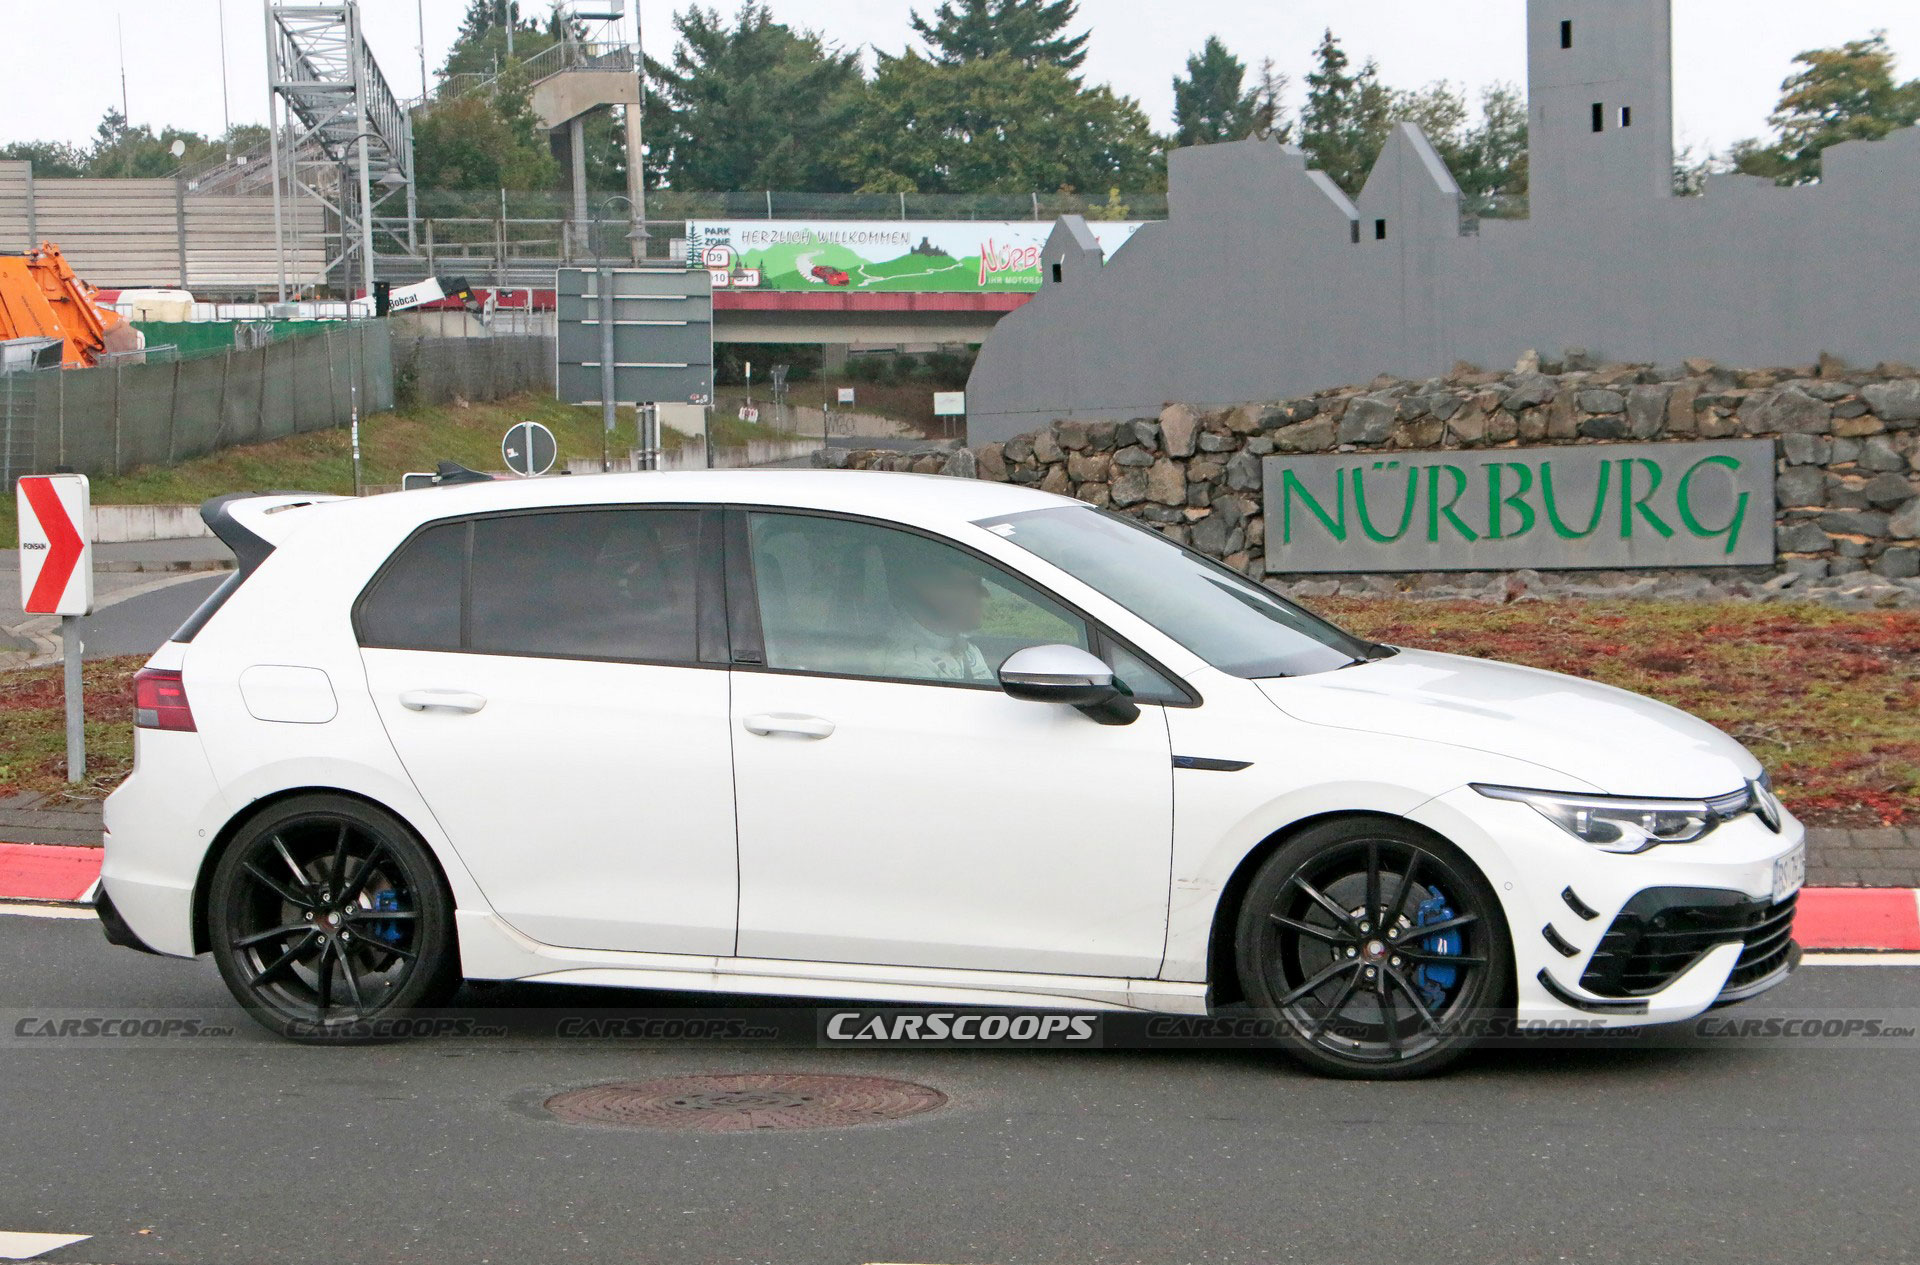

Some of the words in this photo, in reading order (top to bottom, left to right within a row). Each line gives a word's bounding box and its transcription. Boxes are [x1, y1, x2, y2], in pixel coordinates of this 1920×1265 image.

[704, 227, 730, 235] PARK
[704, 237, 731, 246] ZONE
[742, 231, 811, 245] HERZLICH
[817, 231, 911, 245] WILLKOMMEN
[708, 253, 722, 262] D9
[978, 237, 1042, 286] NÜRB
[712, 273, 726, 282] 10
[988, 276, 1002, 284] IHR
[1005, 276, 1042, 284] MOTORS
[390, 293, 418, 308] Bobcat
[1281, 455, 1751, 555] NÜRBURG
